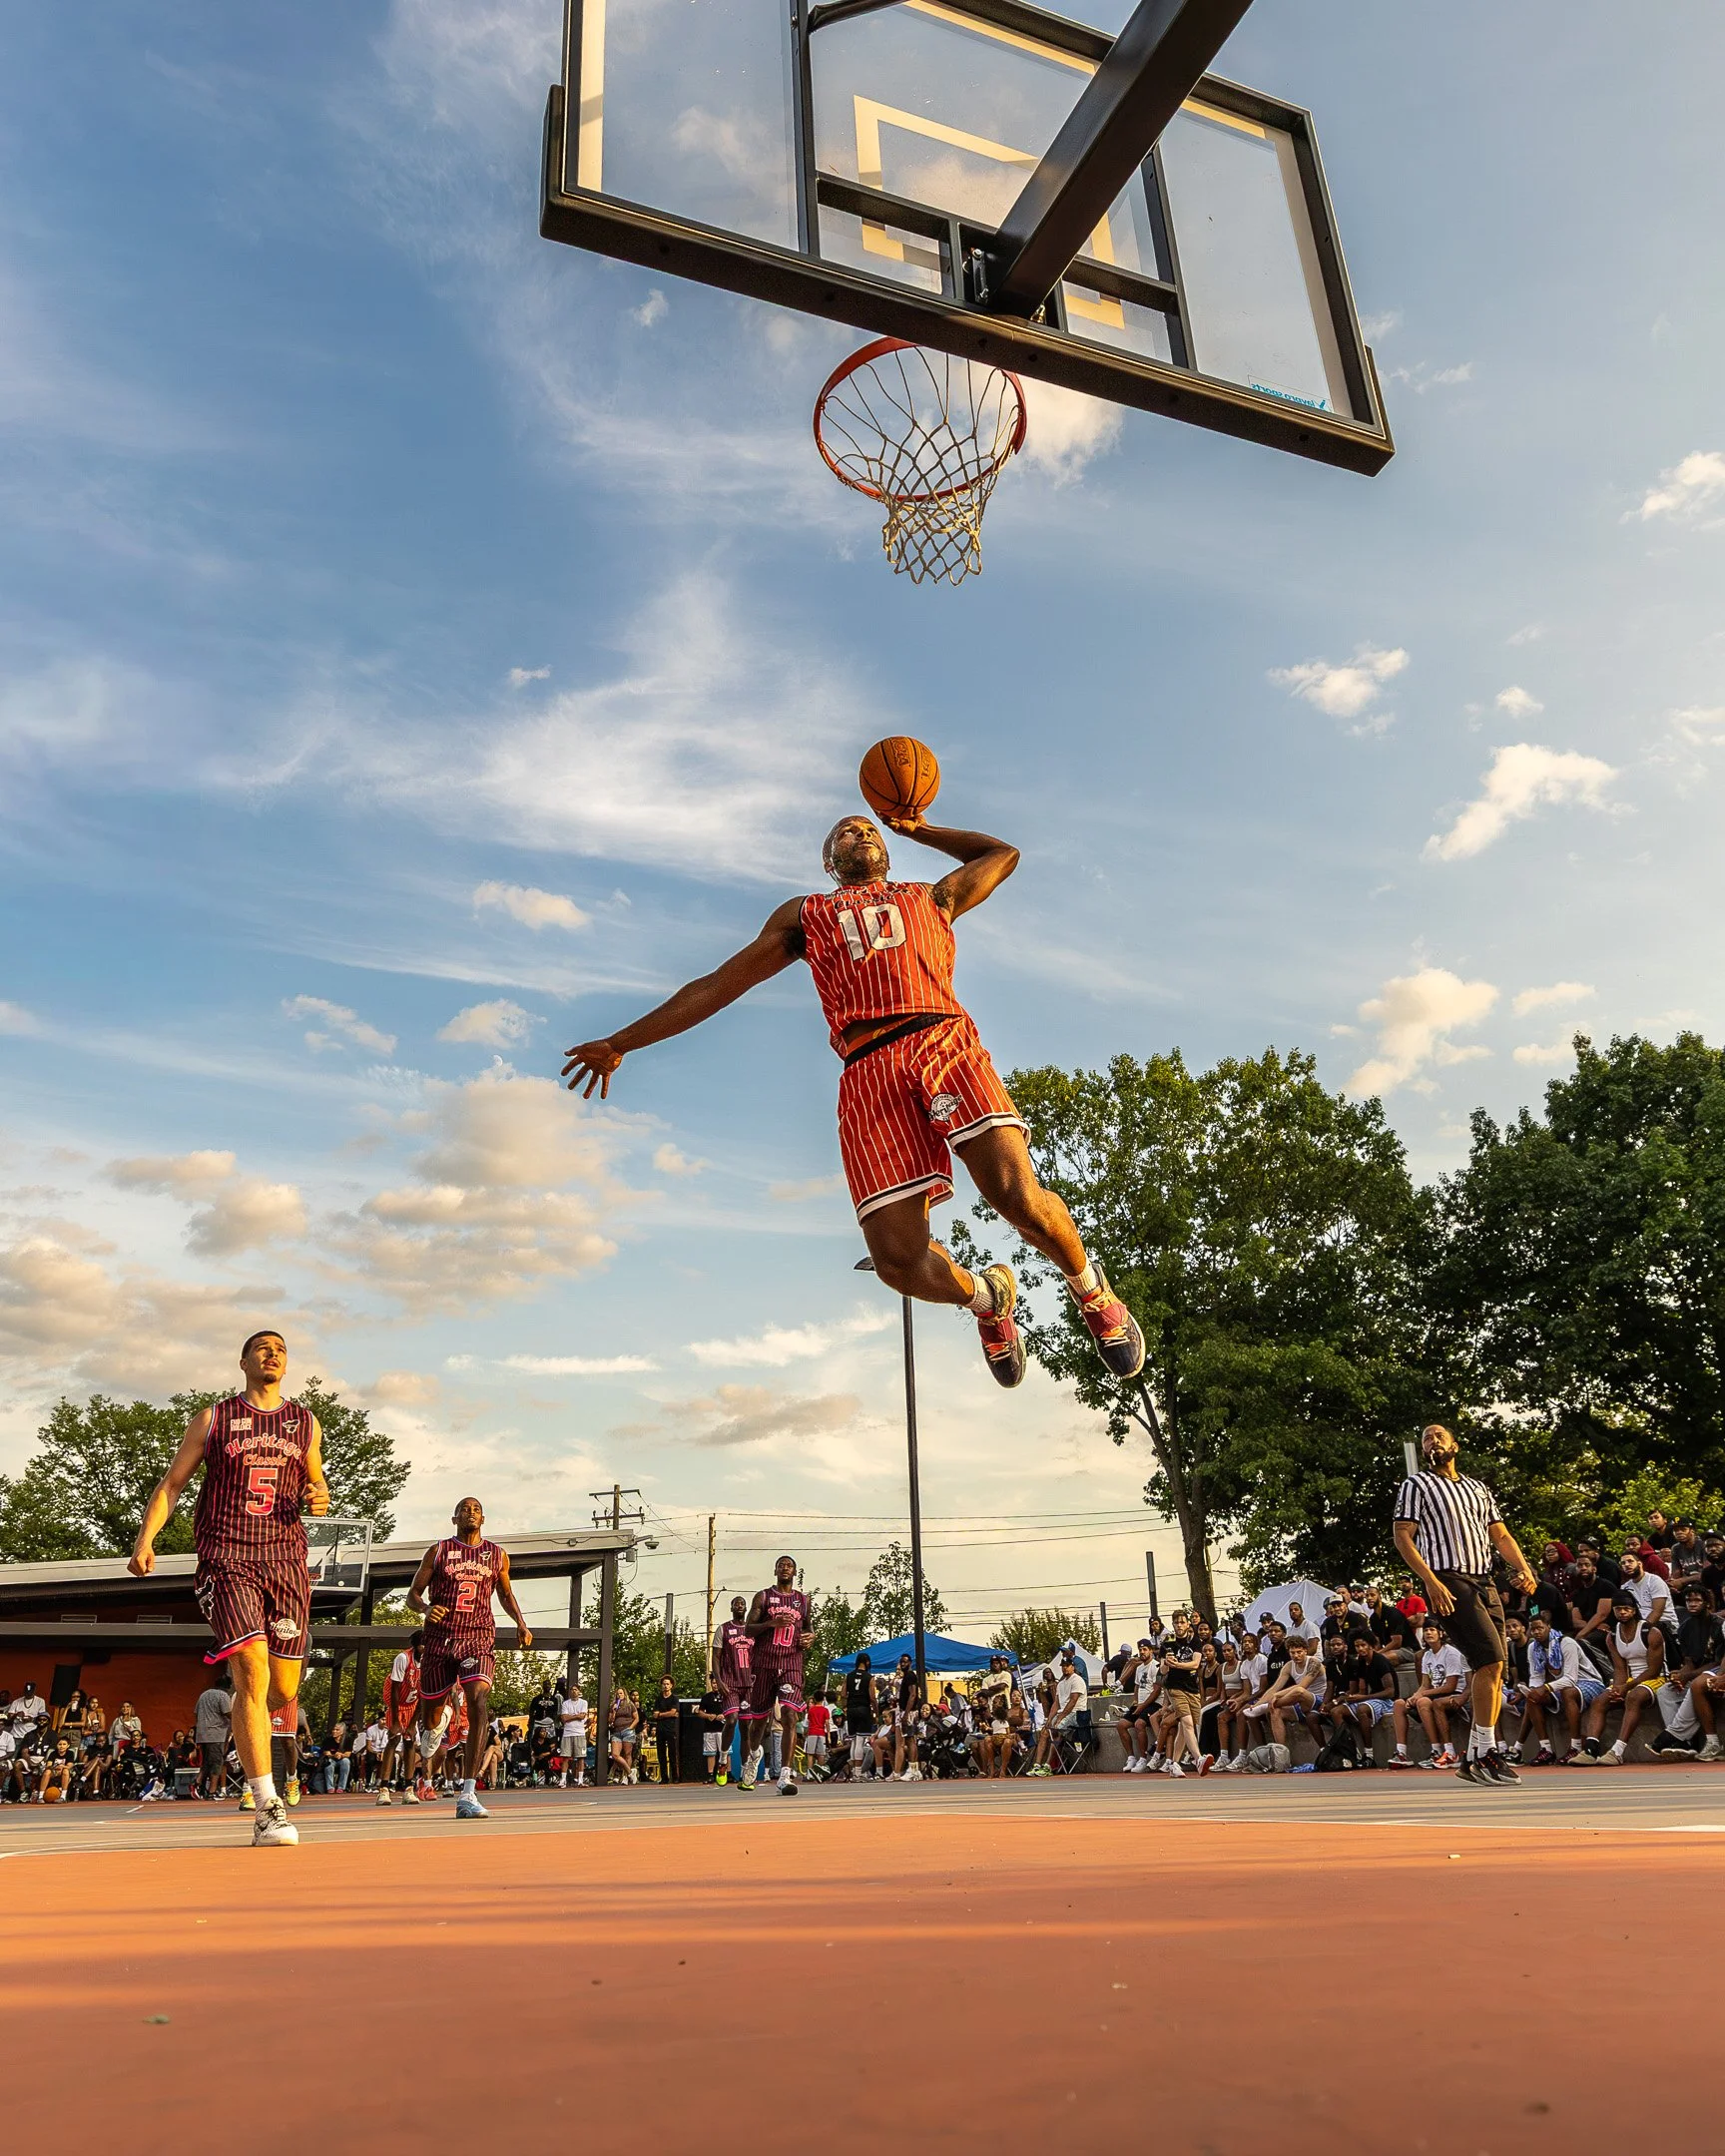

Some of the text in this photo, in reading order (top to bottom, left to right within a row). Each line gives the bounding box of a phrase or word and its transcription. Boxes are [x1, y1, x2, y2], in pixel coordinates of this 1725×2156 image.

[837, 903, 906, 961] 10
[225, 1432, 301, 1460] Heritage
[243, 1454, 288, 1466] Classic
[245, 1468, 278, 1516] 5
[445, 1560, 492, 1577] Heritage
[455, 1581, 477, 1613] 2
[773, 1623, 795, 1647] 10
[738, 1648, 750, 1668] 11
[855, 1679, 861, 1690] 7
